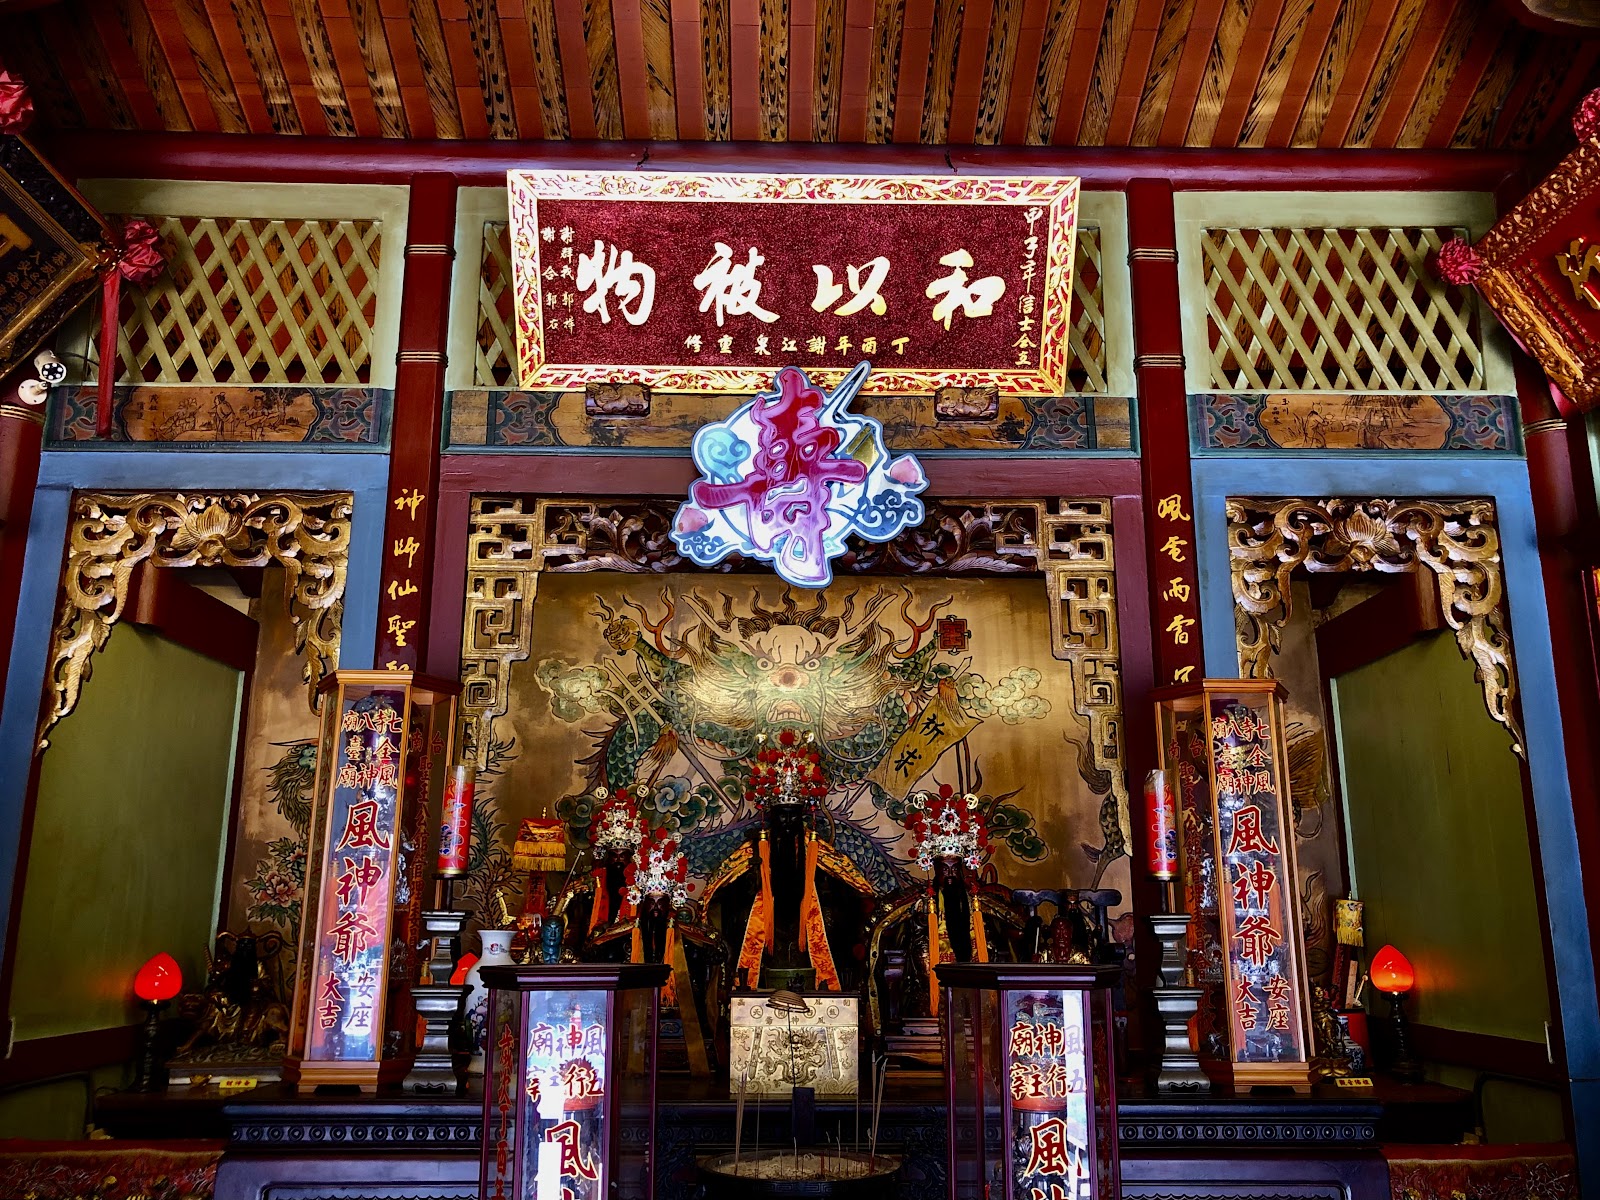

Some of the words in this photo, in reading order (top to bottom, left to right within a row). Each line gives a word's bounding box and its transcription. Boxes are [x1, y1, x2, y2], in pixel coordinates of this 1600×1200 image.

[326, 800, 390, 964] 風神爺
[1226, 805, 1280, 967] 風神爺
